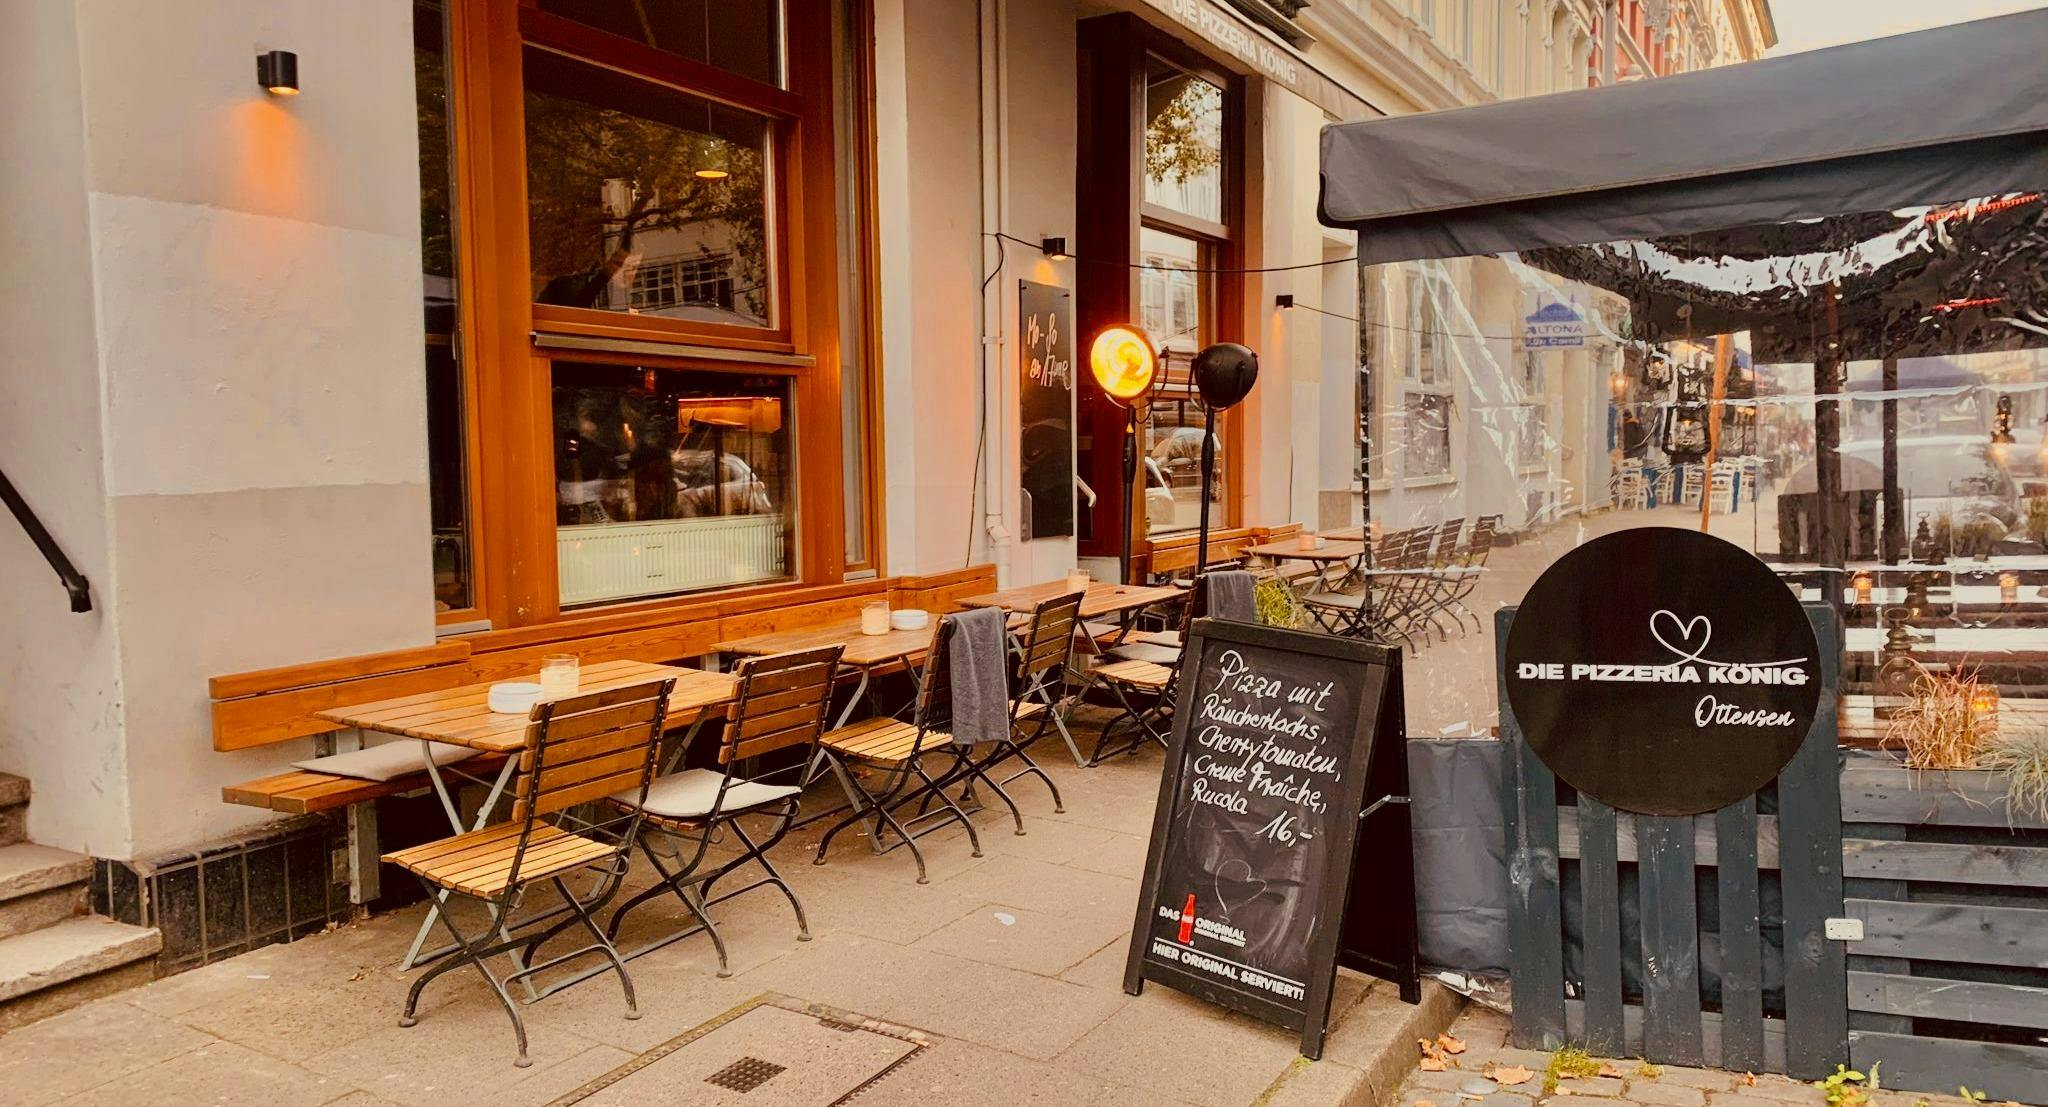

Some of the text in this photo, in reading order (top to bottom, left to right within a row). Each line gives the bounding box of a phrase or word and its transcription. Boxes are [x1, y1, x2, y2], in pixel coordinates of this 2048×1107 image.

[1200, 6, 1257, 62] PIZZERIA
[1260, 45, 1297, 84] KÖNIG
[1213, 649, 1335, 712] Pizza mit
[1518, 663, 1807, 685] DIE PIZZERIA KÖNIG
[1695, 694, 1796, 728] Ottensen
[1198, 725, 1341, 783] Cherrytomaten,
[1190, 777, 1248, 815] Rucola
[1247, 761, 1327, 815] Fraîche,
[1159, 906, 1181, 922] DAS
[1194, 917, 1247, 942] ORIGINAL
[1152, 943, 1306, 1001] HIER ORIGINAL SERVIERT!
